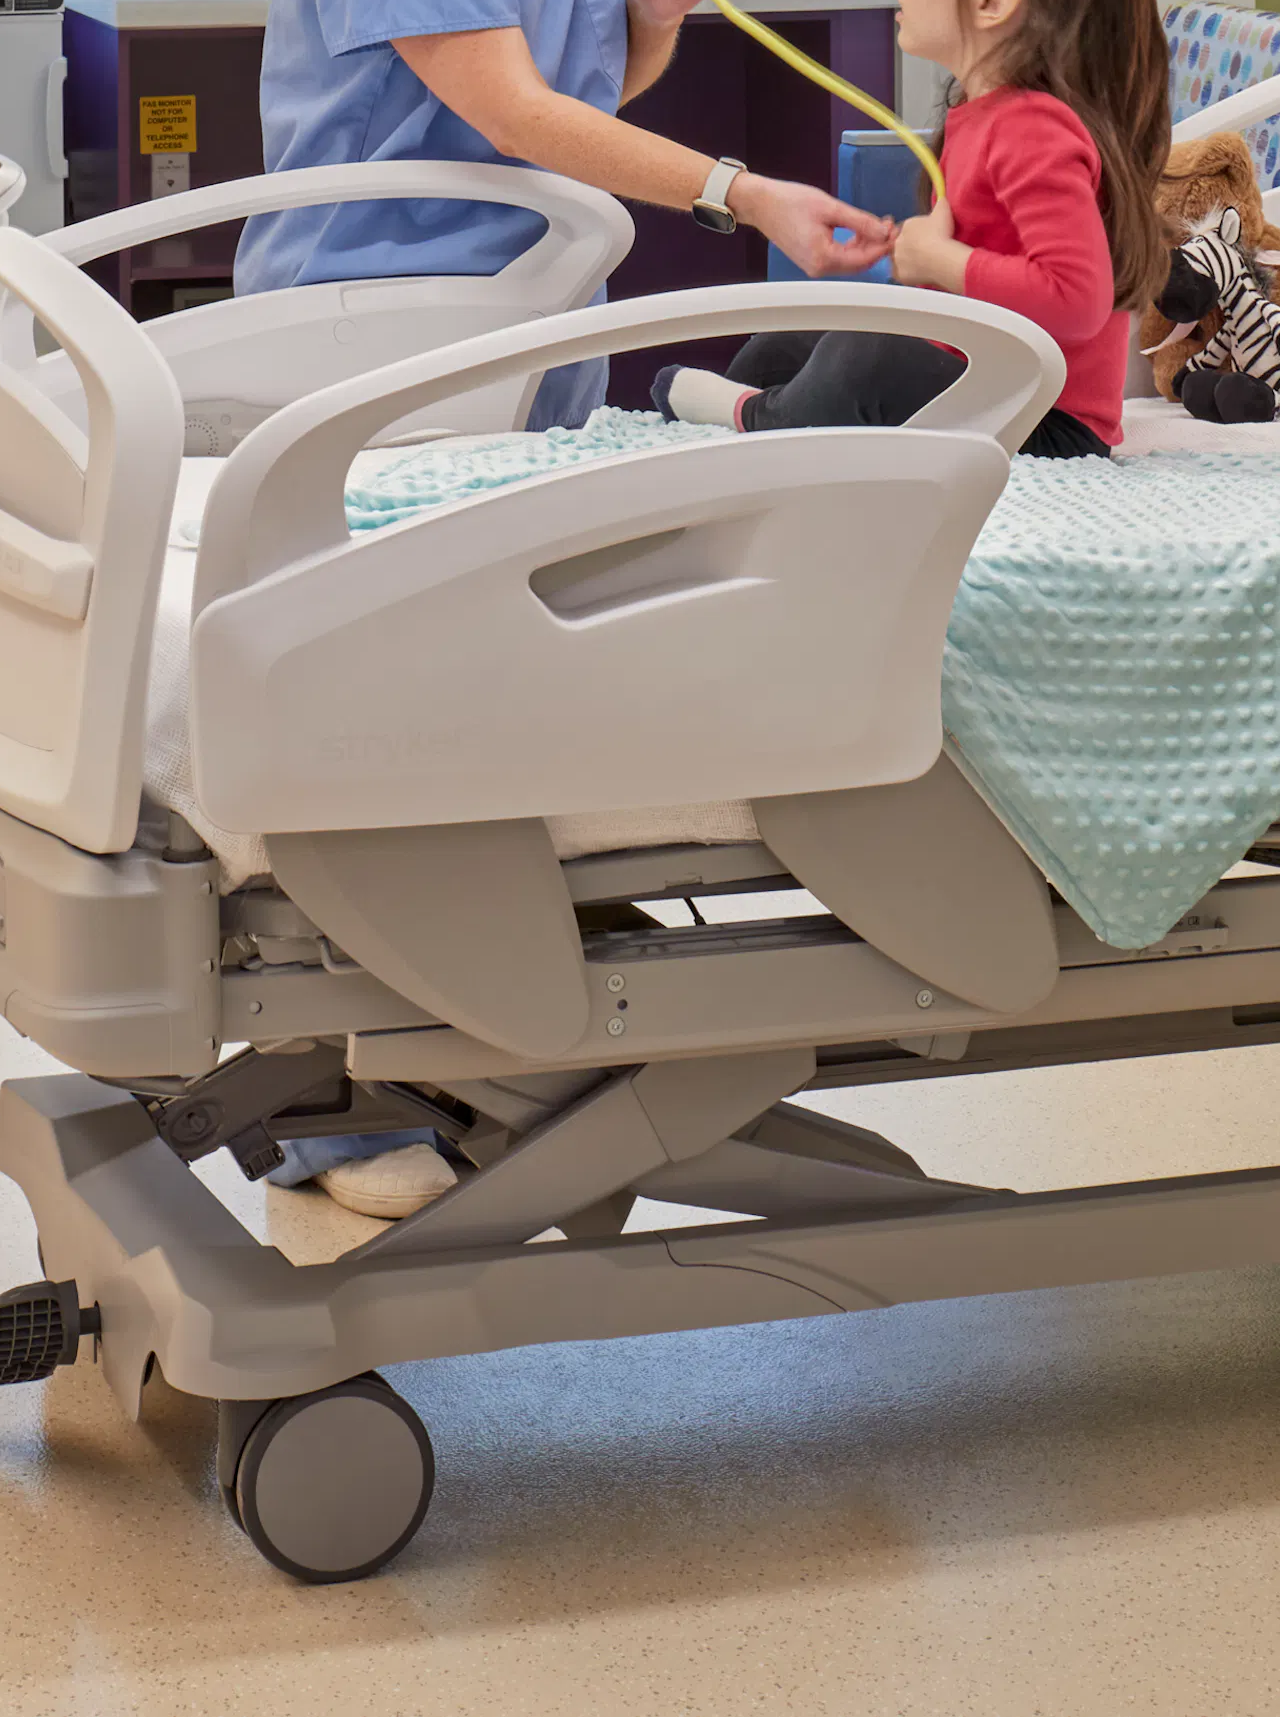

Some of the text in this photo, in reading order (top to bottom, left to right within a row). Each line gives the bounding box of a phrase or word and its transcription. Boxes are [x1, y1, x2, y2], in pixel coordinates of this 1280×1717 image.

[158, 99, 192, 107] MONITOR
[151, 108, 184, 116] NOT FOR
[147, 116, 188, 125] COMPUTER
[146, 133, 189, 141] TELEPHONE
[153, 142, 183, 150] ACCESS
